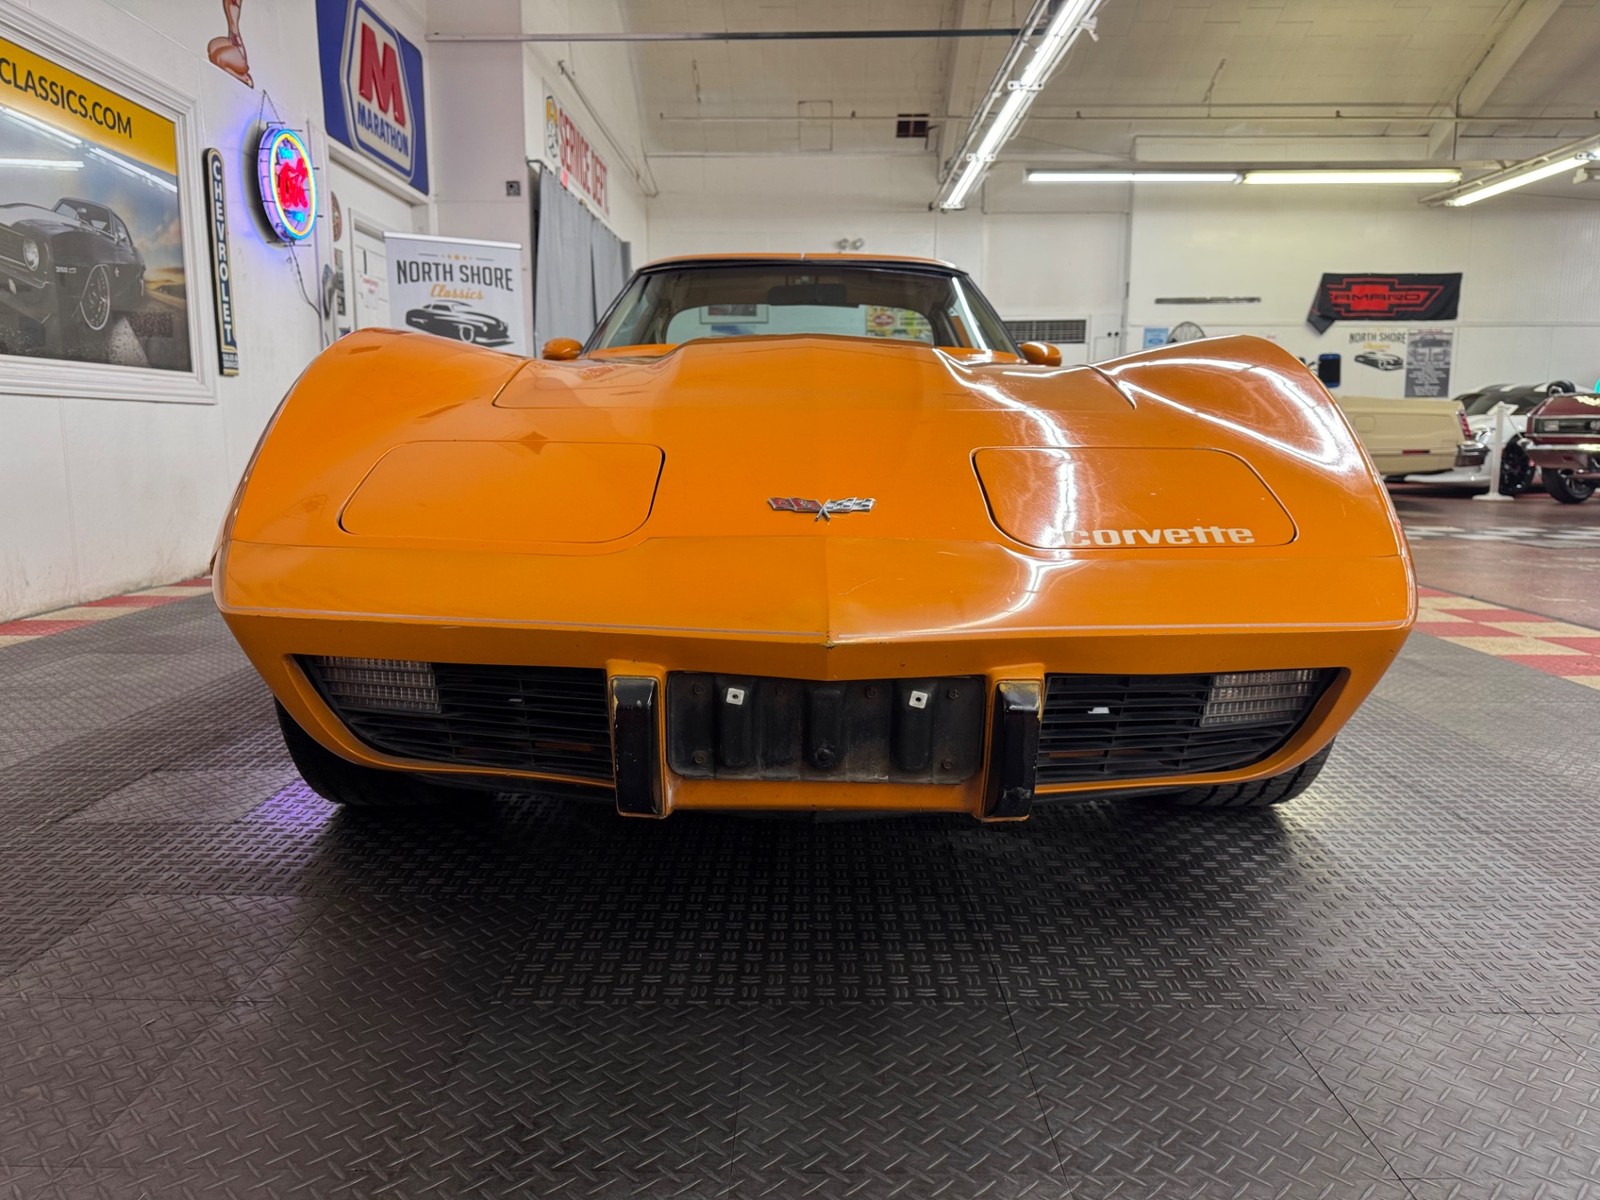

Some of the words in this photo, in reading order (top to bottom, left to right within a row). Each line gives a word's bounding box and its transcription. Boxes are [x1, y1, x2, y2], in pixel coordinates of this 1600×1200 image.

[358, 21, 406, 129] M
[0, 57, 132, 139] CLASSICS.COM
[357, 101, 409, 158] MARATHON
[559, 107, 589, 194] SERVICE
[212, 160, 232, 343] CHEVROLET
[396, 259, 454, 285] NORTH
[459, 264, 514, 292] SHORE
[430, 283, 485, 300] Classics
[1330, 291, 1421, 302] AMARO
[1349, 331, 1377, 344] NORTH
[1379, 331, 1406, 344] SHORE
[1062, 526, 1256, 547] corvette
